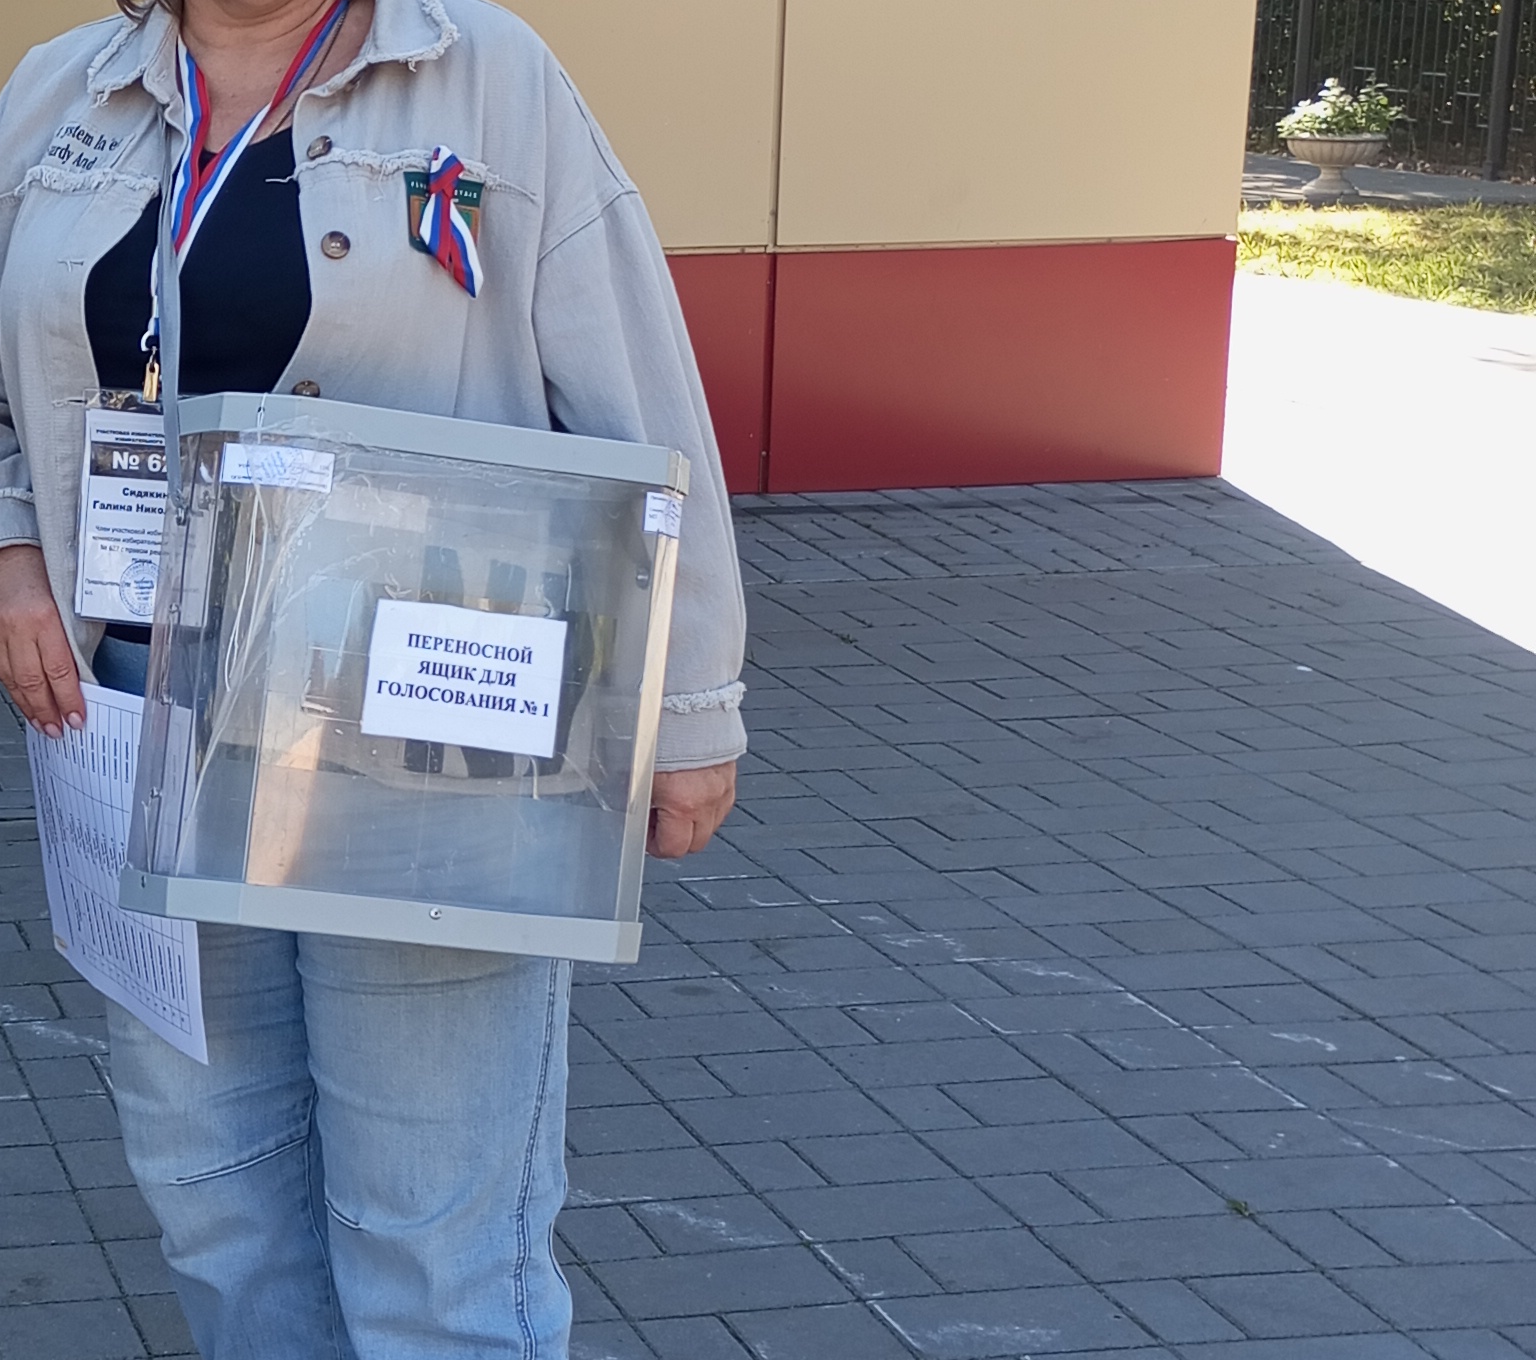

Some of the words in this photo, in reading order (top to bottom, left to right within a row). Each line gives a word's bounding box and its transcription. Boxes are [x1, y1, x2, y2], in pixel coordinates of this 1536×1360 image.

[112, 450, 140, 470] №
[92, 500, 132, 512] Галина
[407, 633, 533, 664] ПЕРЕНОСНОЙ
[417, 660, 478, 682] ЯЩИК
[478, 669, 517, 688] ДЛЯ
[376, 680, 517, 712] ГОЛОСОВАНИЯ
[519, 700, 538, 716] №
[542, 703, 549, 718] 1
